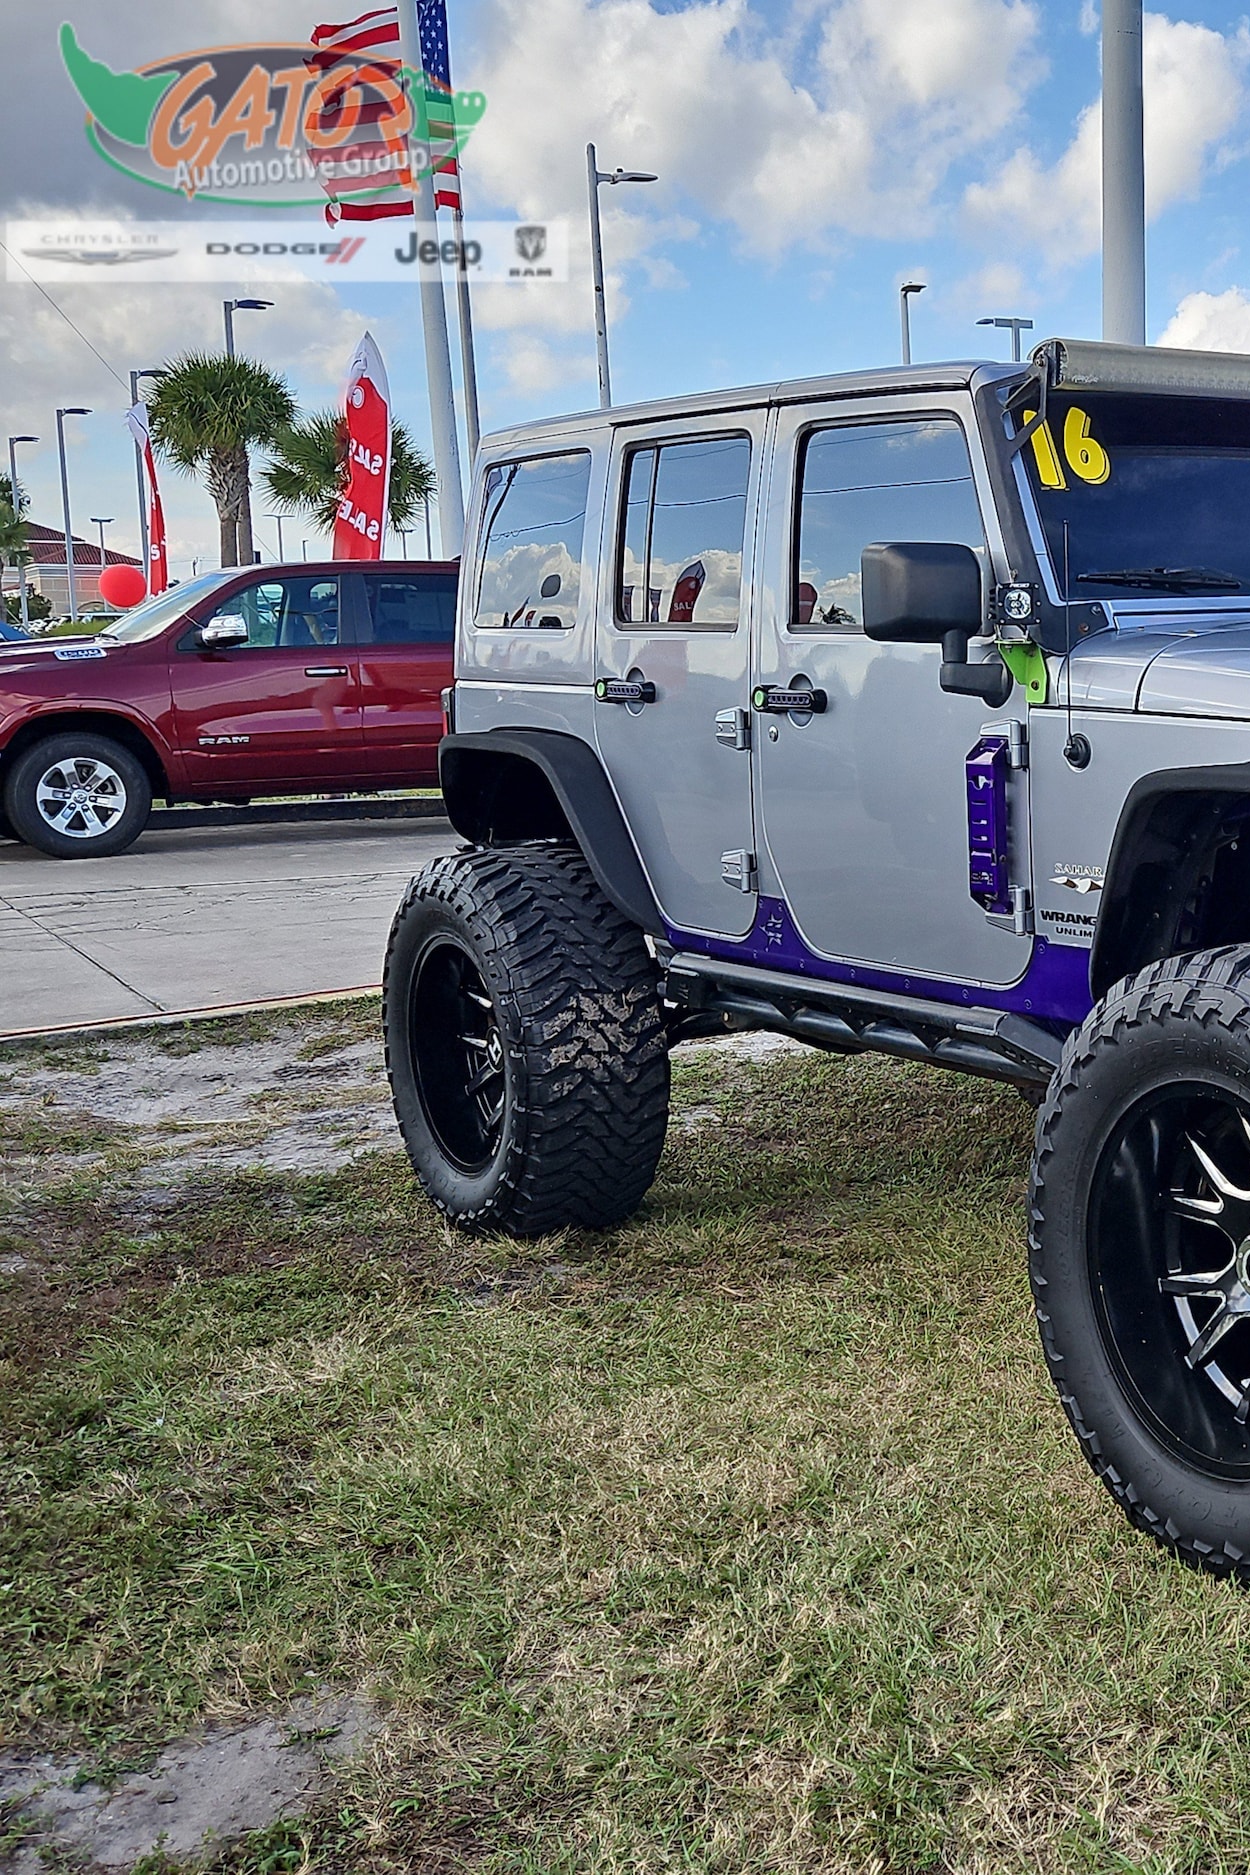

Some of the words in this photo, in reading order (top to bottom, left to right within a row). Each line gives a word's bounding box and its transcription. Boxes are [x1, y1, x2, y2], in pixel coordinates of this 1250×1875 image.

[1023, 406, 1111, 489] 16
[198, 736, 250, 745] RAM
[1054, 862, 1105, 878] SAHAR
[1040, 909, 1098, 926] WRANG
[1055, 926, 1093, 938] UNLIM
